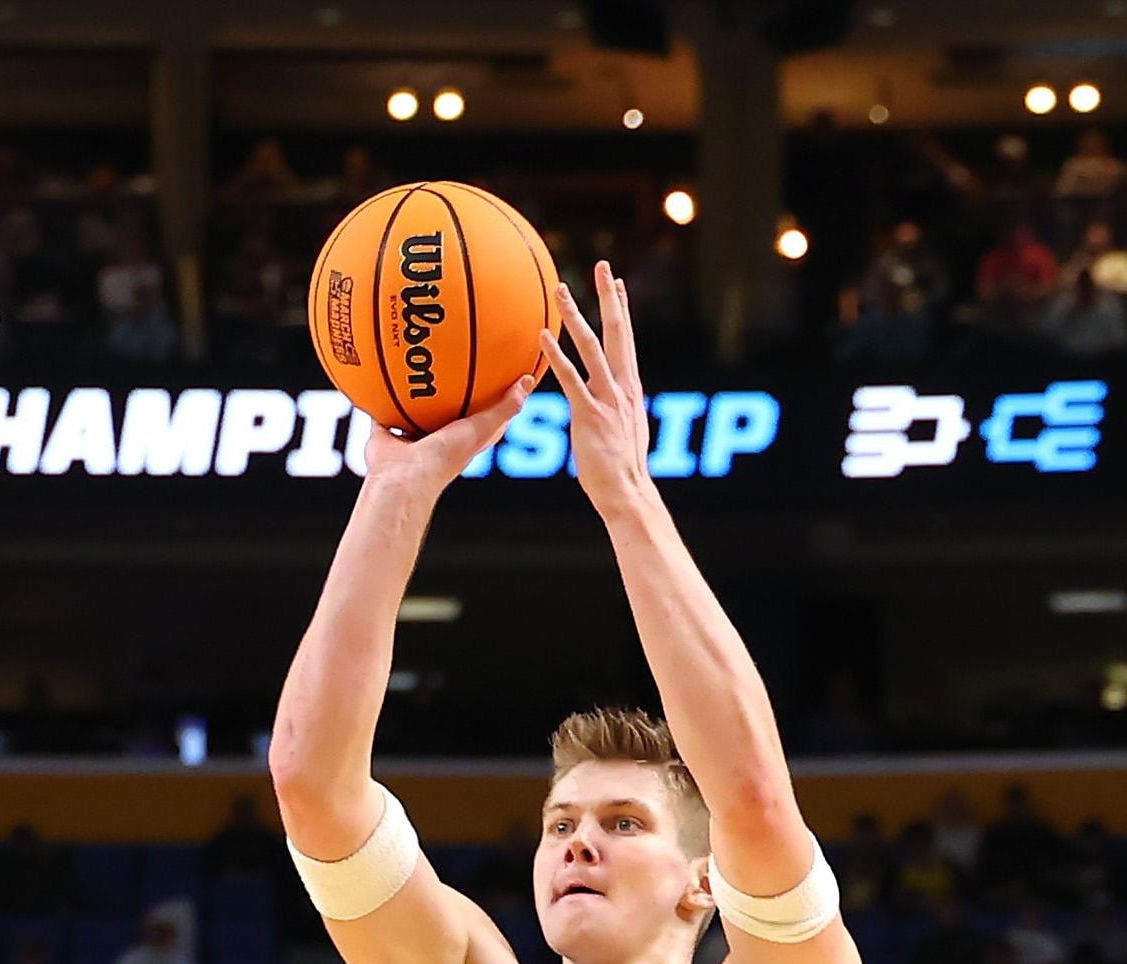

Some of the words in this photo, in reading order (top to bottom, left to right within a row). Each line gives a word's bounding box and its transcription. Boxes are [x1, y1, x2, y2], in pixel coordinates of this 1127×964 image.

[390, 295, 399, 320] EVO
[400, 230, 446, 400] Wilson
[391, 323, 401, 348] NXT
